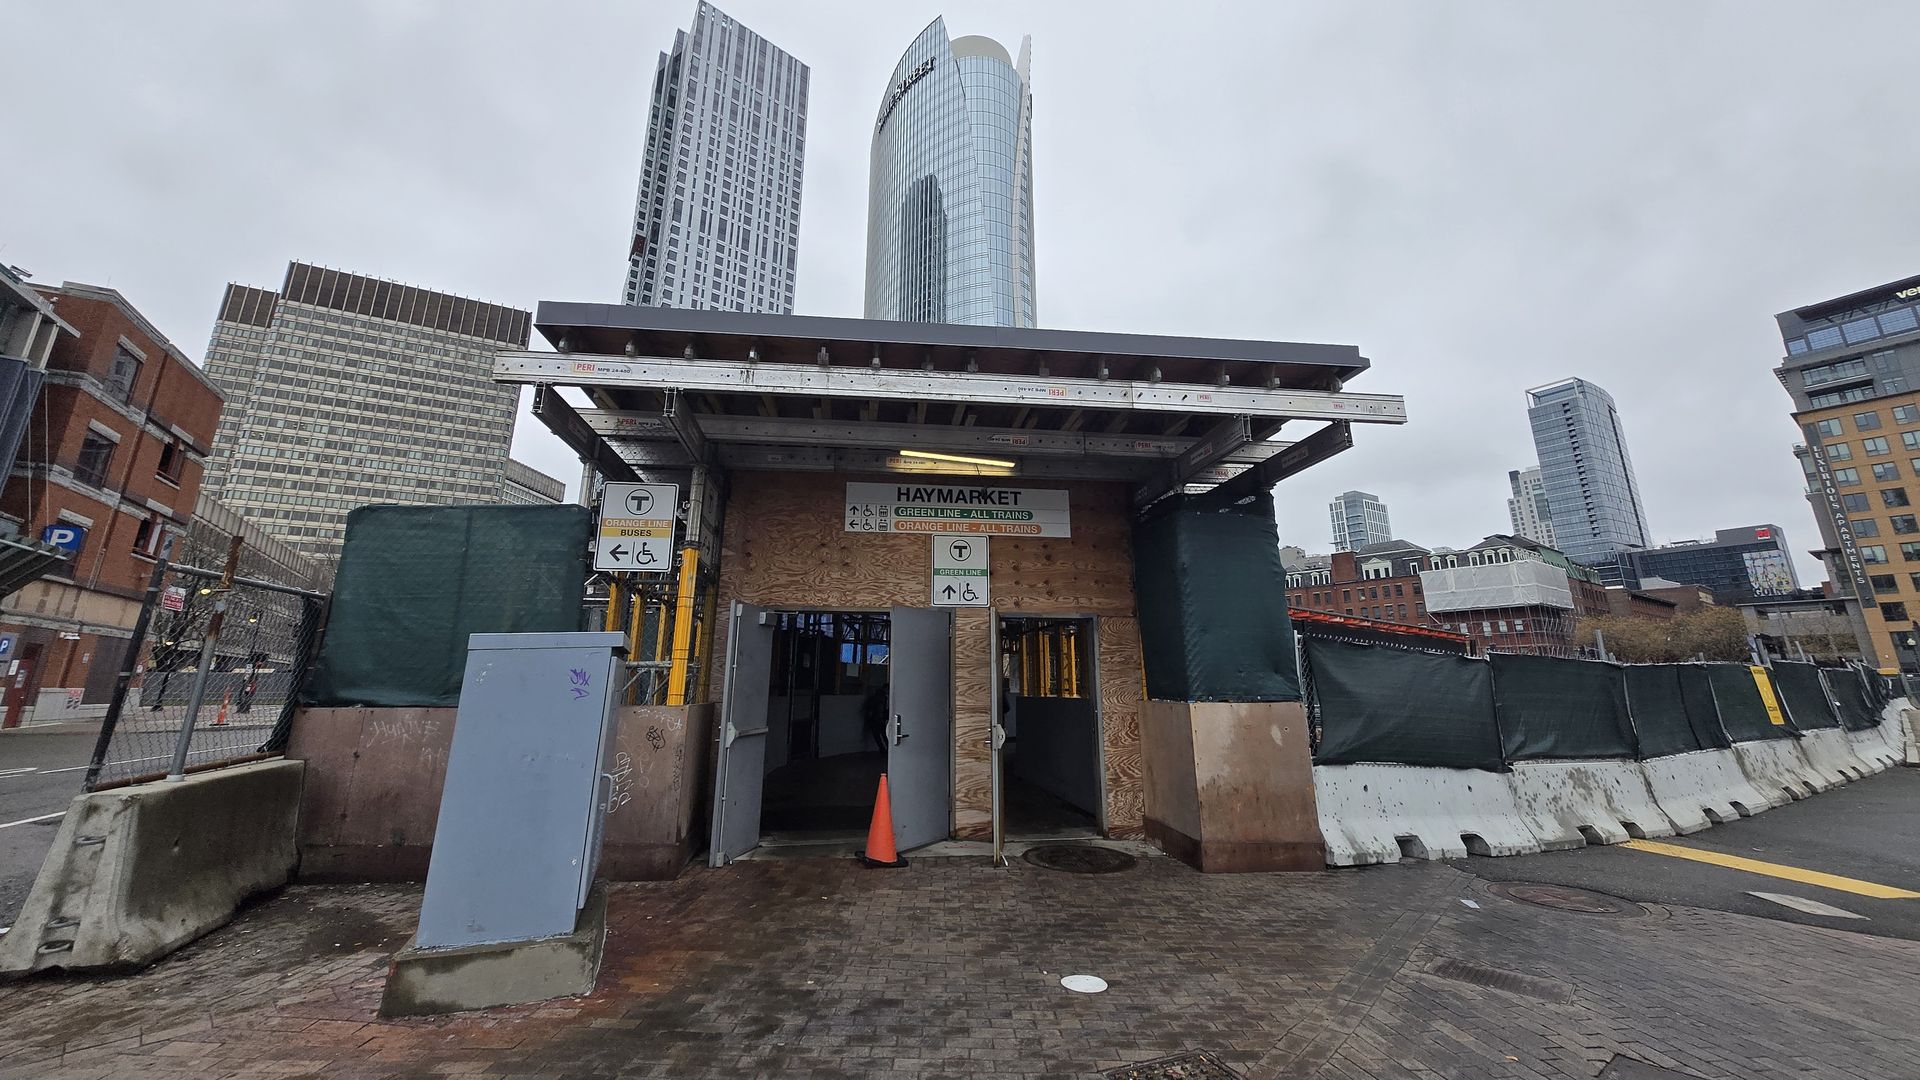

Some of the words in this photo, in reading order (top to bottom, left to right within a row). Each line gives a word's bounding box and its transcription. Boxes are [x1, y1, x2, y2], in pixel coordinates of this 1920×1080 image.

[576, 363, 595, 371] PERI
[1048, 388, 1064, 396] PERI
[897, 487, 1022, 505] HAYMARKET
[898, 508, 936, 518] GREEN
[938, 508, 961, 518] LINE
[971, 509, 990, 519] ALL
[992, 510, 1030, 520] TRAINS
[605, 519, 645, 528] ORANGE
[647, 520, 669, 528] LINE
[898, 521, 944, 532] ORANGE
[946, 522, 970, 532] LINE
[979, 523, 998, 533] ALL
[999, 524, 1038, 534] TRAINS
[49, 529, 75, 547] P
[620, 529, 652, 537] BUSES
[1835, 512, 1865, 584] APARTMENTS
[939, 568, 964, 576] GREEN
[965, 568, 982, 576] LINE
